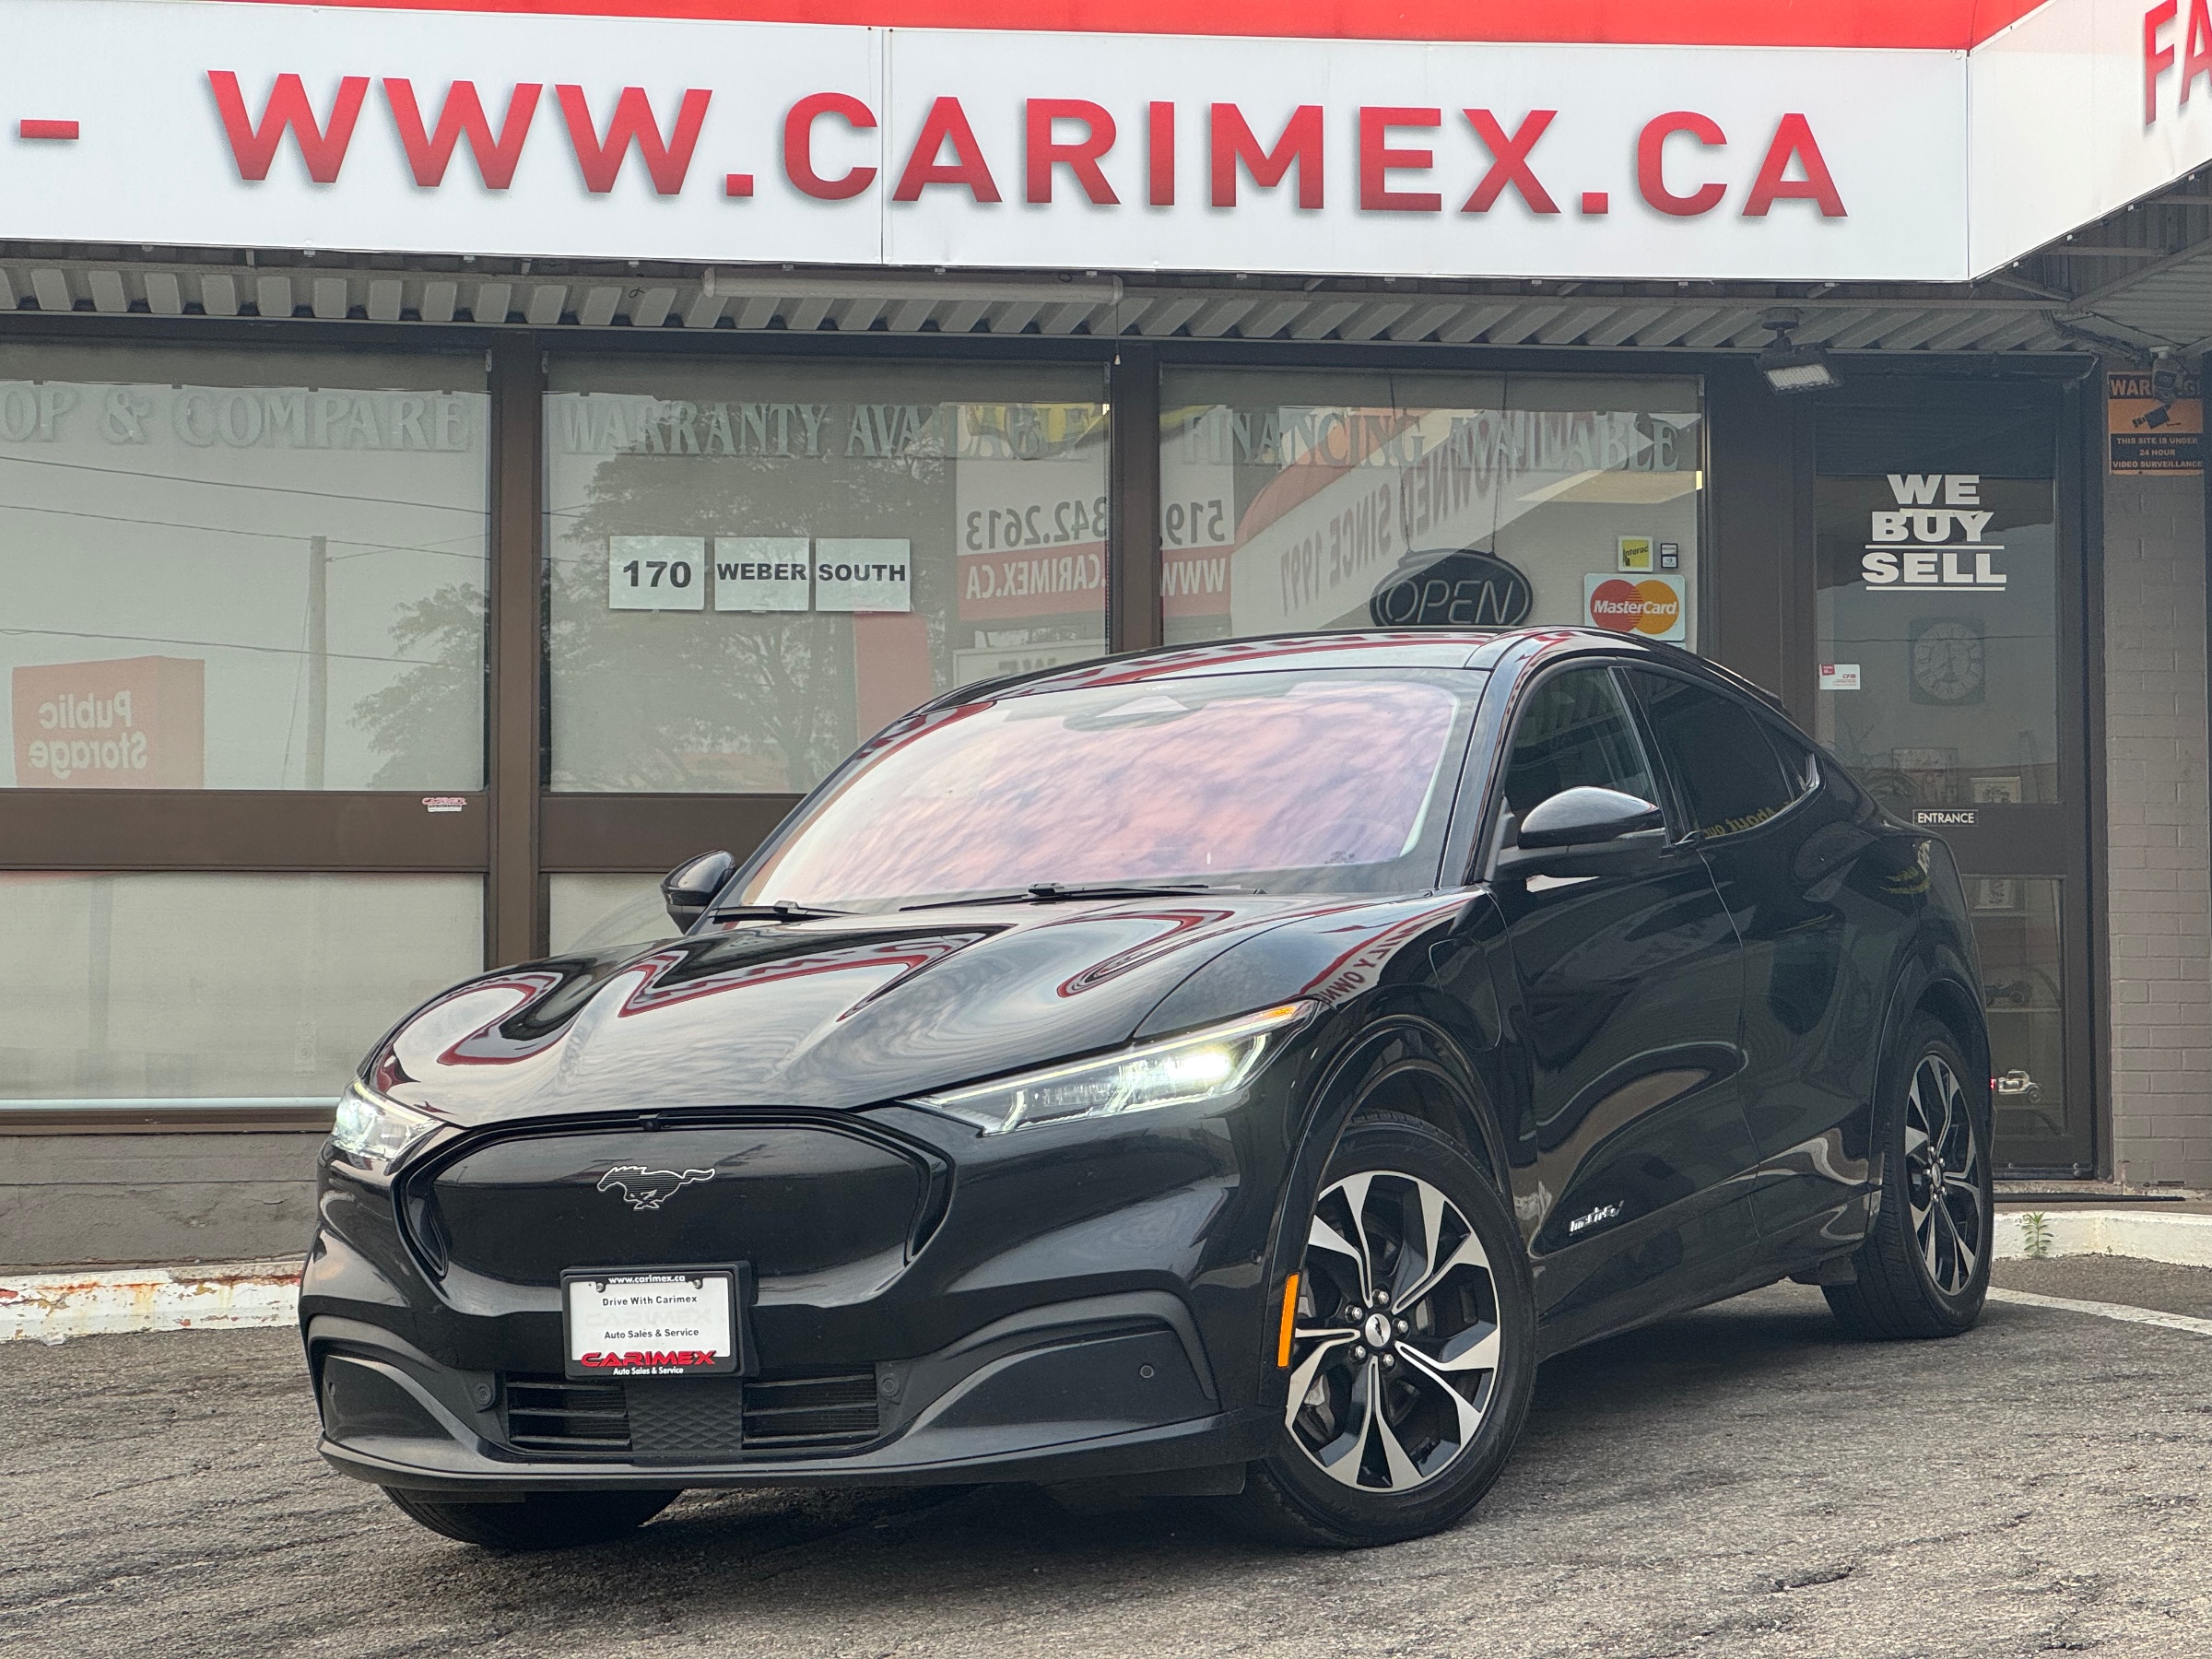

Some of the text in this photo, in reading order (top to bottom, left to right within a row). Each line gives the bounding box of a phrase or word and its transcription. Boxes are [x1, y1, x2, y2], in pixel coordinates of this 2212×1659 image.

[207, 70, 1848, 218] WWW.CARIMEX.CA
[2110, 379, 2201, 396] WARG!
[175, 391, 469, 452] COMPARE
[560, 401, 829, 456] WARRANTY
[1183, 412, 1679, 472] FINANCING AVAILABLE
[1887, 474, 1981, 505] WE
[1871, 511, 1994, 543] BUY
[1622, 545, 1649, 558] Interac
[622, 560, 692, 589] 170
[716, 562, 807, 582] WEBER
[818, 563, 906, 582] SOUTH
[1861, 552, 2007, 584] SELL
[1384, 578, 1513, 626] OPEN
[1594, 599, 1677, 615] MasterCard
[1917, 812, 1975, 824] ENTRANCE
[608, 1274, 686, 1284] www.carimex.ca
[602, 1295, 698, 1306] Drive With Carimex
[604, 1328, 700, 1339] Auto Sales & Service
[581, 1350, 717, 1367] CARIMEX
[613, 1366, 684, 1375] Auto Sales & Service
